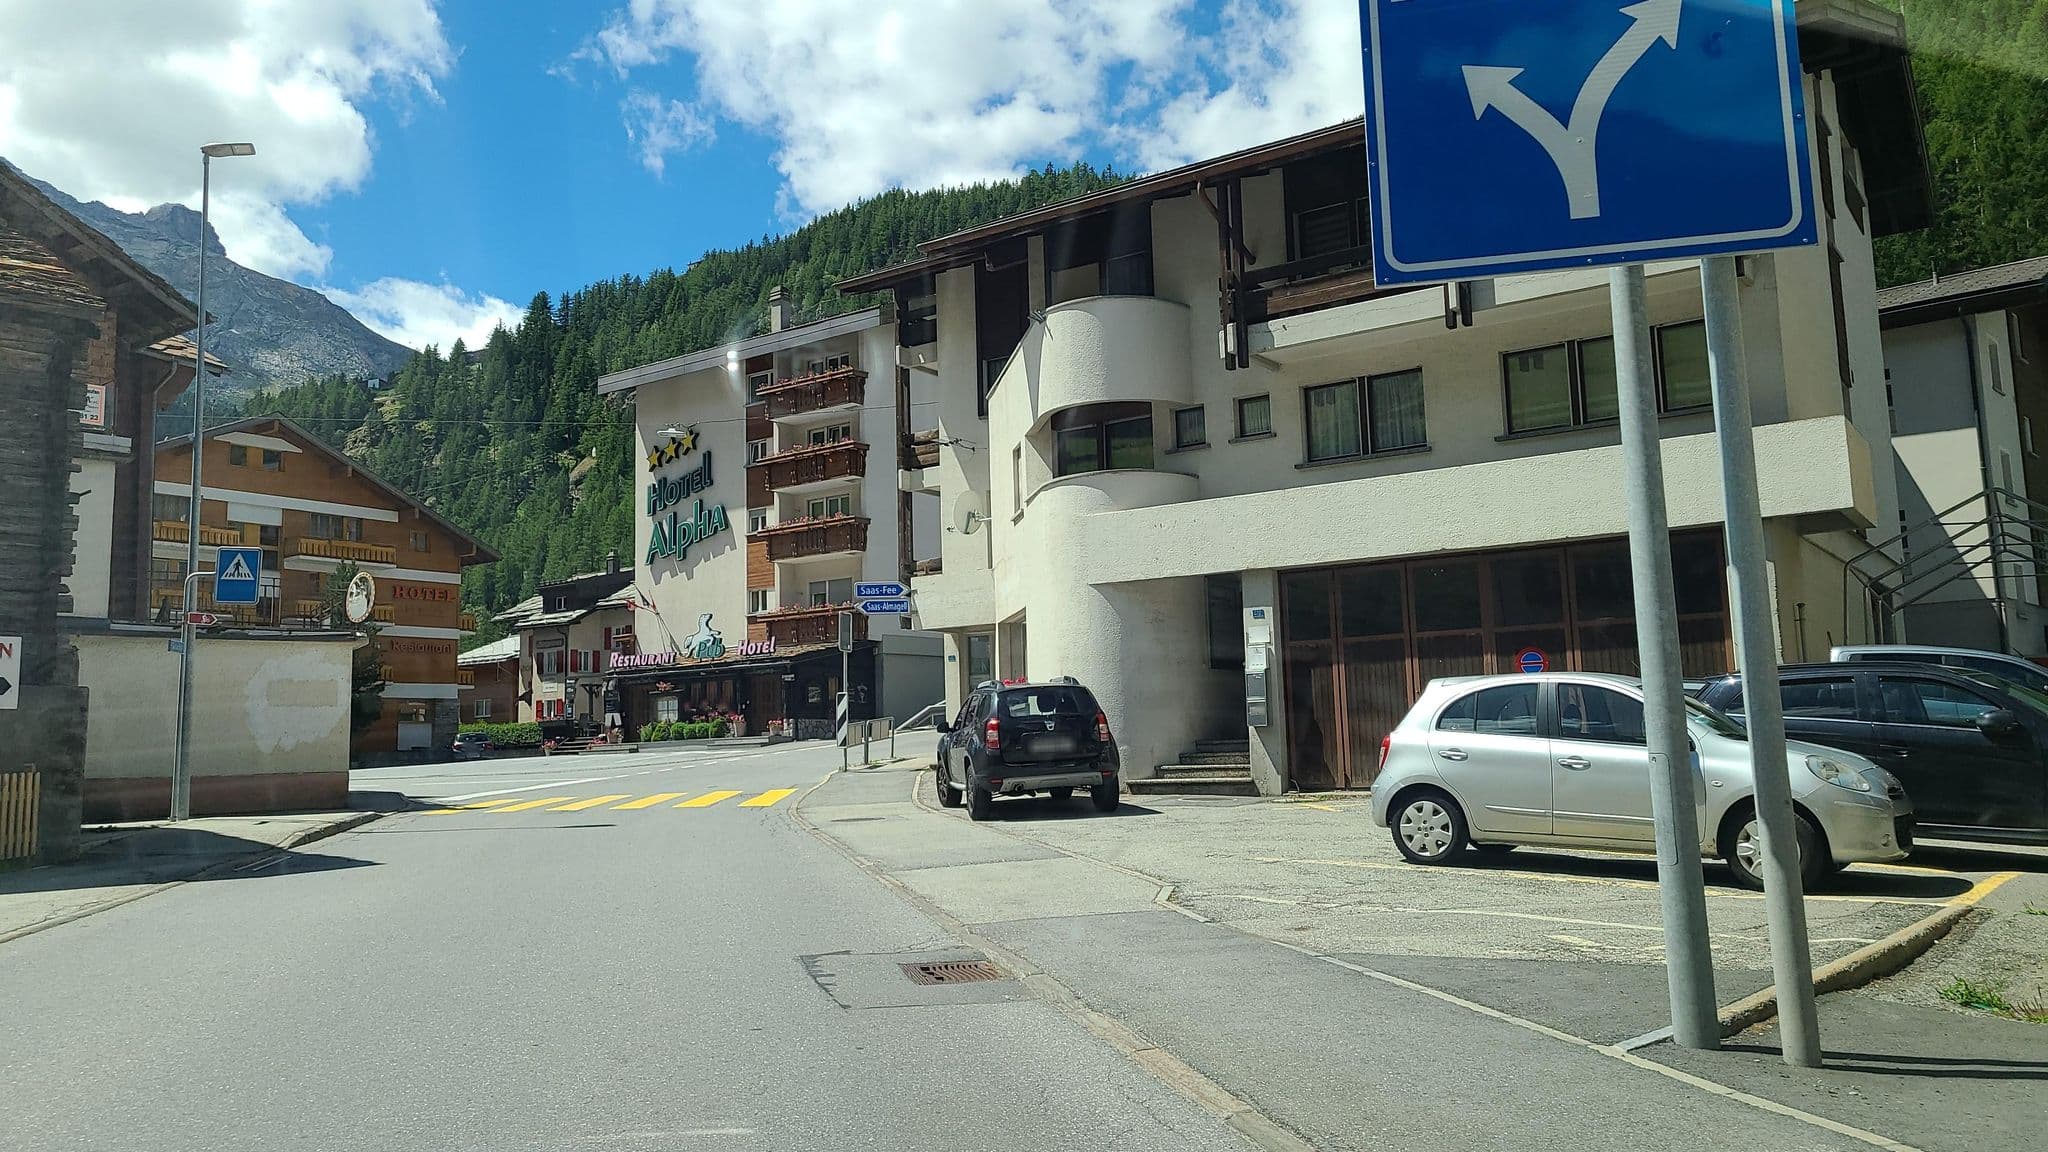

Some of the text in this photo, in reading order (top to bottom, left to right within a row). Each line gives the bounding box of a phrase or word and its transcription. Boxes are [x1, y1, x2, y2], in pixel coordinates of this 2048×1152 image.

[393, 585, 456, 603] HOTEL
[860, 586, 898, 596] Saas-Fee
[866, 602, 908, 613] Saas-Almagell
[697, 638, 726, 658] Pub
